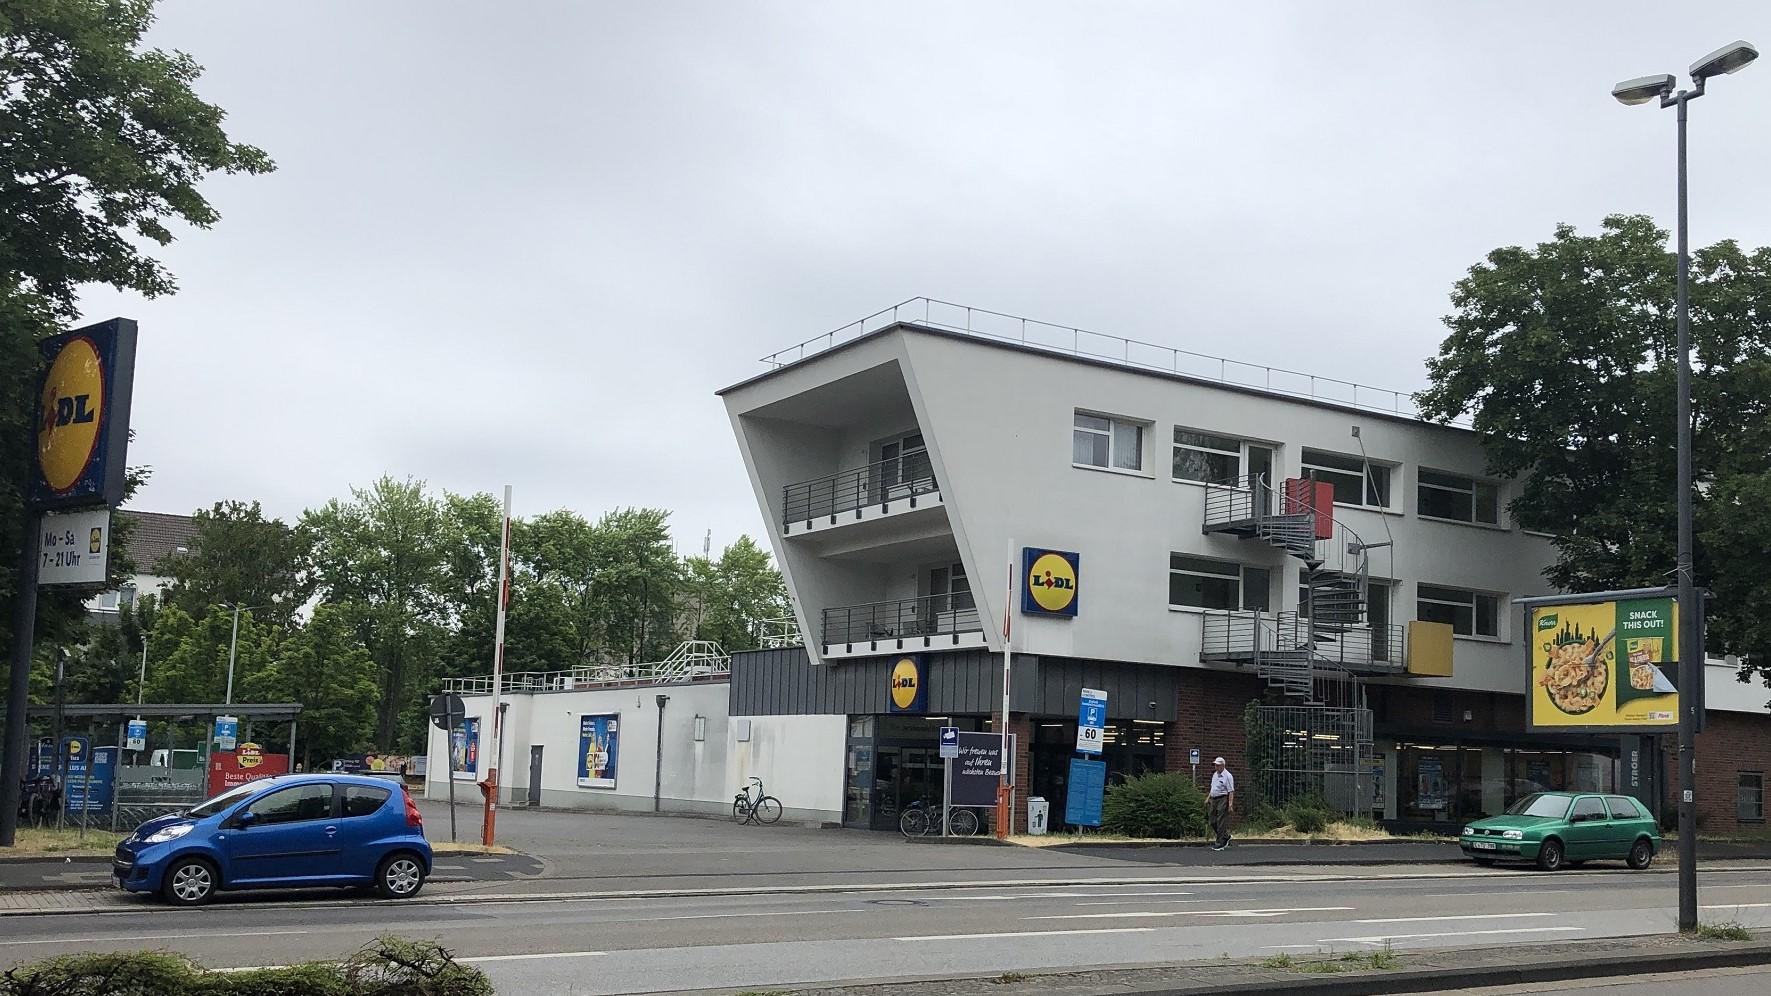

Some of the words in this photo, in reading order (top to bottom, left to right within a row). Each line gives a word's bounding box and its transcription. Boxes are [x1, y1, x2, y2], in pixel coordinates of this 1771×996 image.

[45, 532, 57, 547] Mo
[65, 530, 75, 546] Sa
[43, 552, 48, 568] 7
[55, 552, 64, 567] 21
[65, 551, 81, 567] Uhr
[1032, 570, 1073, 590] LIDL
[1629, 610, 1658, 620] SNACK
[1623, 620, 1642, 630] THIS
[1643, 619, 1664, 629] OUT!
[893, 675, 915, 690] LIDL
[1085, 728, 1096, 740] 60
[969, 746, 987, 756] freuen
[974, 756, 993, 766] Ihren
[225, 772, 244, 780] Beste
